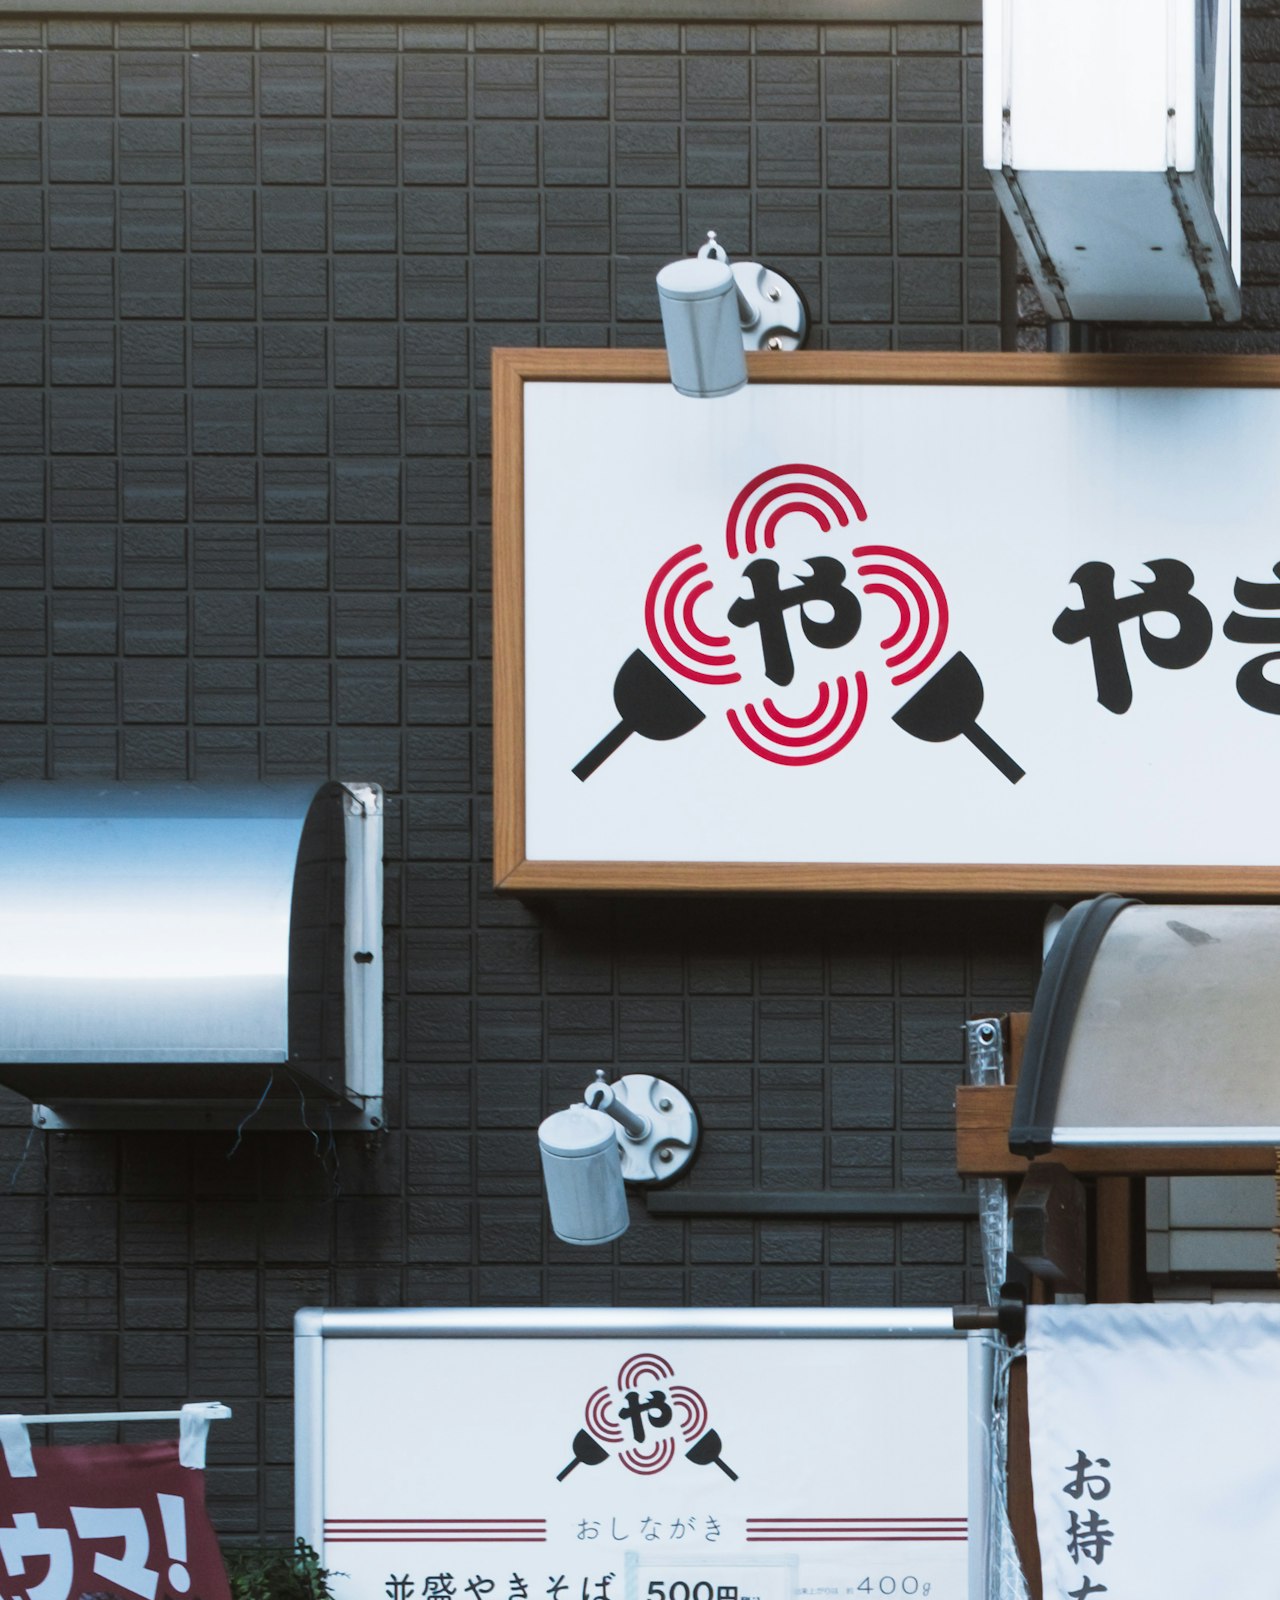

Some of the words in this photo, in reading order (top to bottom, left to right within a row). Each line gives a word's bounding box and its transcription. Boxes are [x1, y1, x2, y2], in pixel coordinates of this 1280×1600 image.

[728, 554, 862, 686] や
[618, 1390, 673, 1442] や
[576, 1515, 724, 1543] おしながき
[857, 1575, 931, 1597] 400g
